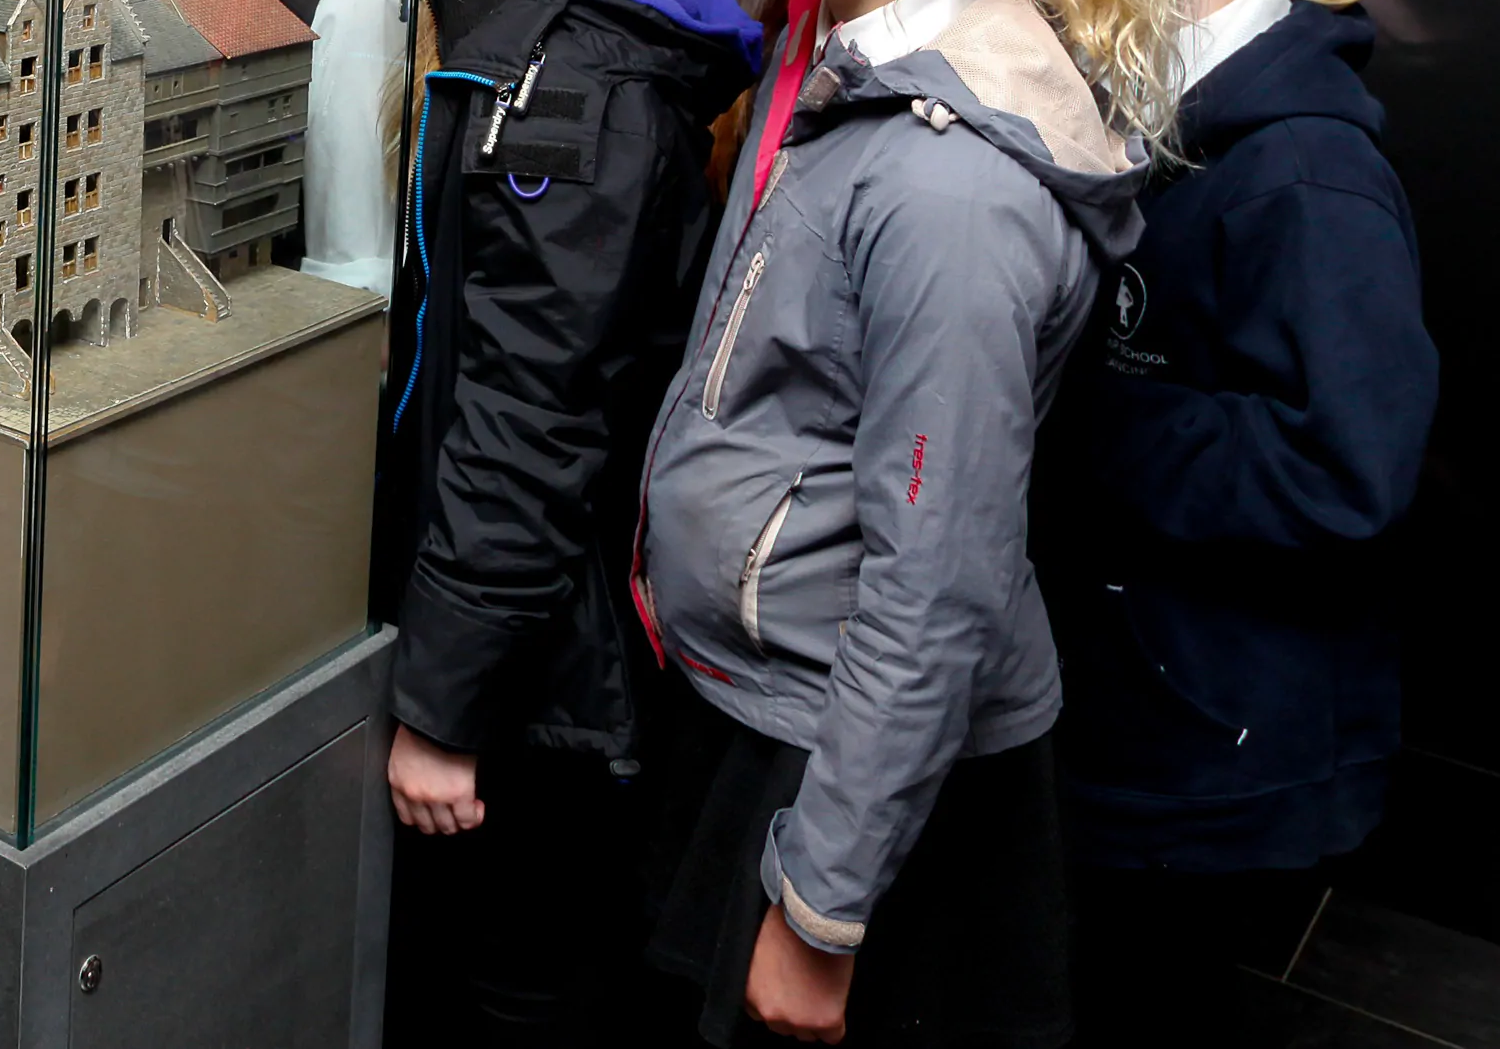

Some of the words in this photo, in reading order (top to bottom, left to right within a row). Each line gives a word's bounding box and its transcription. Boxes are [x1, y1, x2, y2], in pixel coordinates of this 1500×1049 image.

[513, 64, 538, 108] Superdry
[482, 107, 506, 154] Superdry
[1120, 342, 1170, 365] SCHOOL
[906, 433, 928, 506] tres-tex
